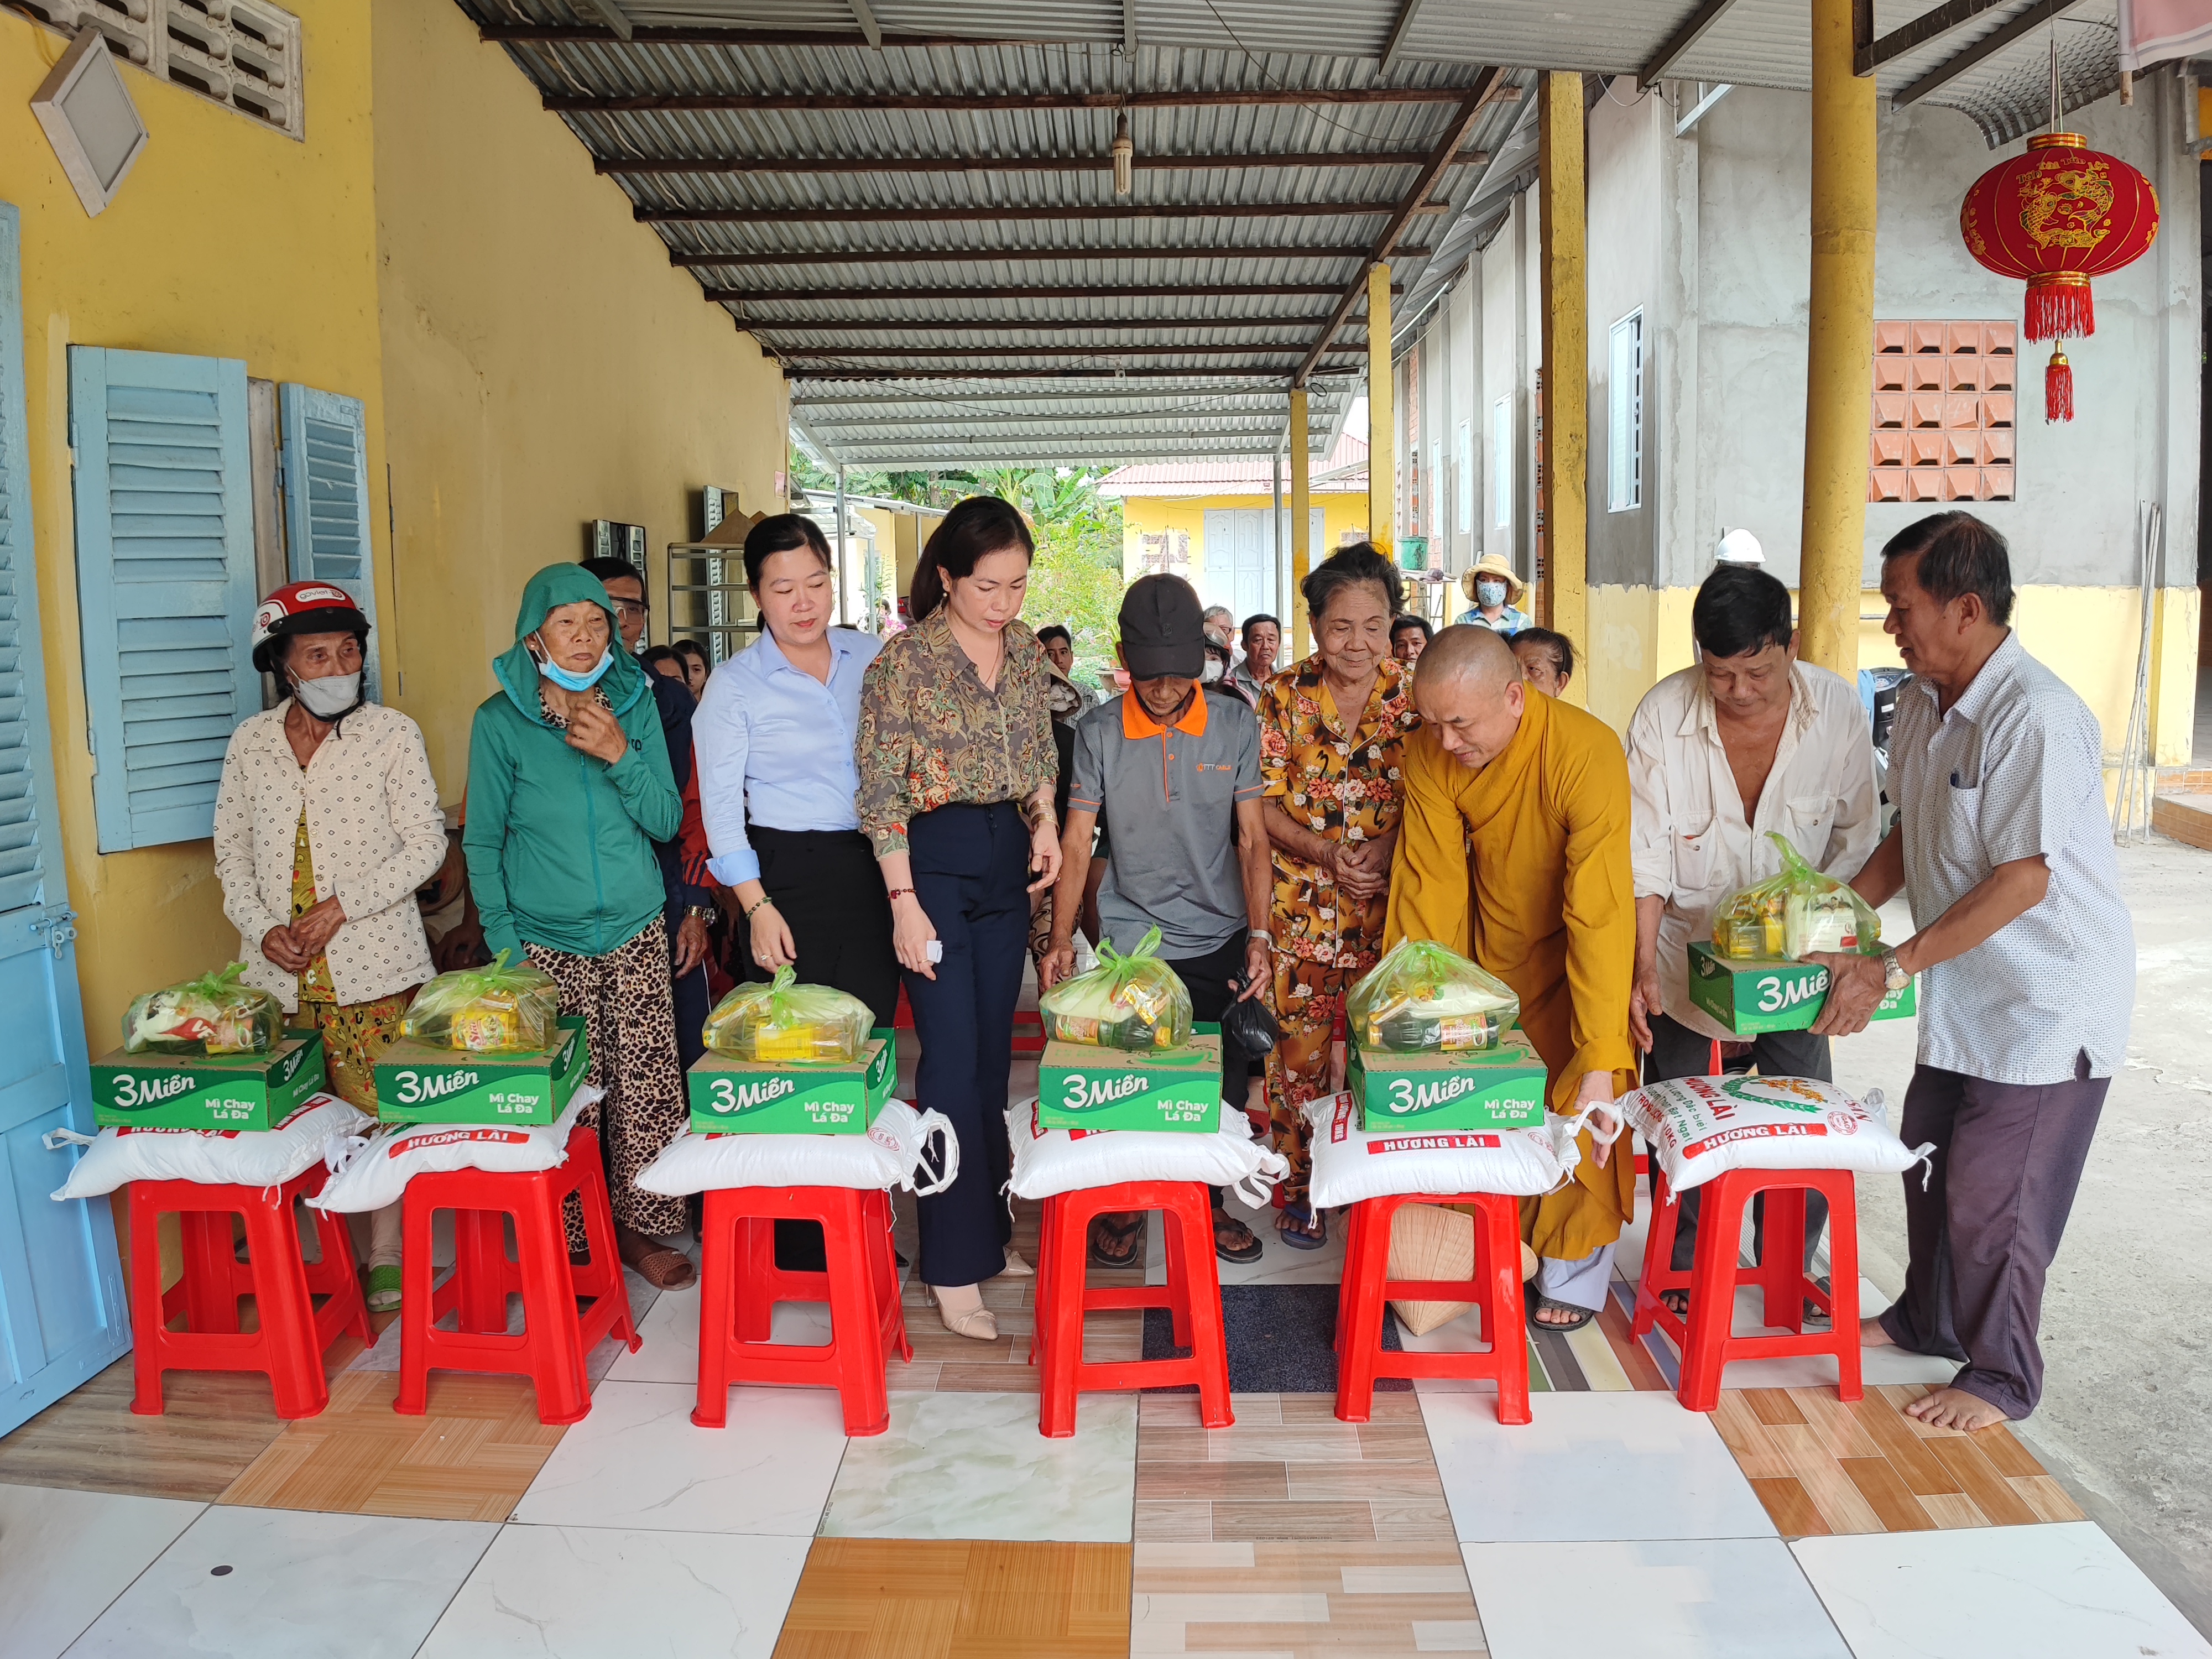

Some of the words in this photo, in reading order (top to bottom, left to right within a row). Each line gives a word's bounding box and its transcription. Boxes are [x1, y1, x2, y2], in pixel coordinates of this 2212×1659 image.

[205, 1098, 220, 1108] Mì
[223, 1098, 255, 1111] Chay
[489, 1093, 503, 1103] Mì
[507, 1093, 539, 1105] Chay
[1484, 1099, 1499, 1109] Mì
[1503, 1099, 1536, 1110] Chay
[498, 1103, 512, 1113] Lá
[515, 1104, 533, 1114] Đa
[804, 1101, 820, 1112] Mì
[822, 1101, 855, 1114] Chay
[1157, 1099, 1173, 1110] Mì
[1176, 1100, 1209, 1113] Chay
[213, 1108, 228, 1119] Lá
[231, 1109, 249, 1119] Đa
[812, 1112, 827, 1122] Lá
[830, 1113, 848, 1123] Đa
[1165, 1110, 1180, 1121] Lá
[1182, 1112, 1201, 1121] Đa
[1491, 1108, 1506, 1119] Lá
[1509, 1110, 1527, 1119] Đa
[408, 1131, 470, 1148] HƯƠNG
[477, 1129, 509, 1141] LÀI
[1703, 1126, 1770, 1150] HƯƠNG
[1773, 1123, 1807, 1135] LÀI
[1383, 1137, 1449, 1151] HƯƠNG
[1455, 1135, 1485, 1147] LÀI
